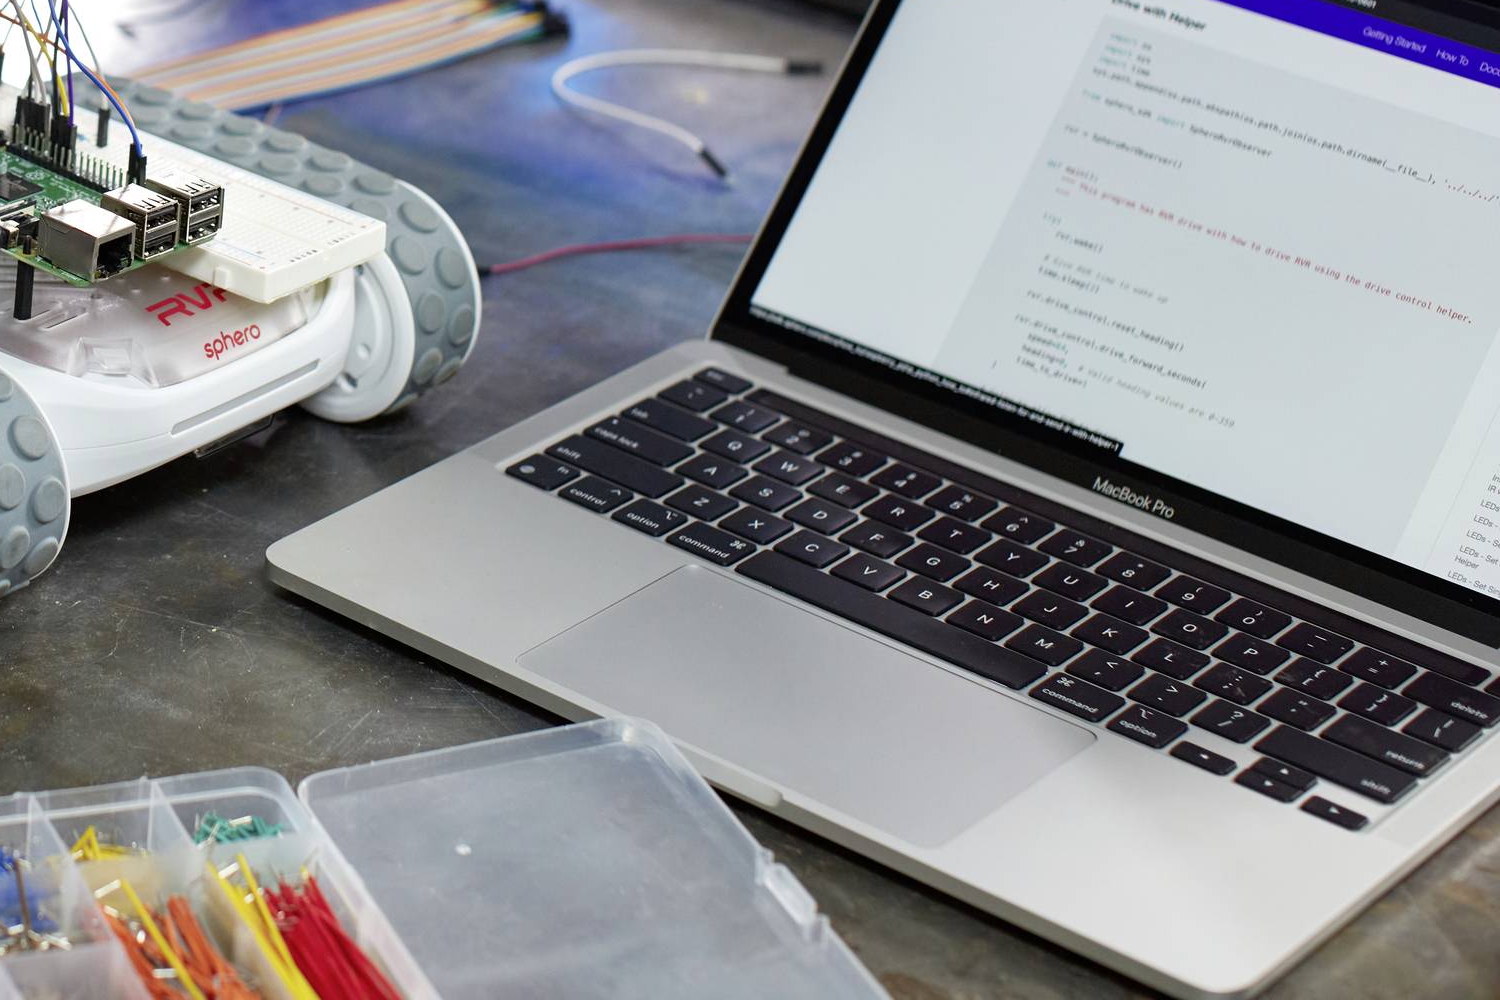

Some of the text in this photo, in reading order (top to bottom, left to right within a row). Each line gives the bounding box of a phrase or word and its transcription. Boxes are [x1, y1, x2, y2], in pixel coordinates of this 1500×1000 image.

[1143, 2, 1166, 19] with
[1168, 10, 1206, 31] Helper
[1363, 26, 1394, 45] Getting
[1395, 35, 1427, 53] Started
[1436, 48, 1457, 63] How
[1459, 54, 1469, 66] To
[1265, 246, 1291, 262] drive
[1295, 255, 1311, 269] RVR
[1315, 264, 1341, 281] using
[1345, 273, 1361, 286] the
[1364, 280, 1391, 297] drive
[1395, 290, 1433, 310] control
[1436, 304, 1473, 325] helper.
[204, 324, 261, 360] sphero
[703, 465, 718, 476] A
[780, 460, 799, 473] W
[758, 487, 773, 498] S
[836, 484, 850, 495] E
[569, 486, 607, 506] control
[1092, 476, 1175, 519] MacBook Pro
[694, 497, 709, 507] Z
[1480, 499, 1500, 512] LEDs
[813, 510, 828, 520] D
[890, 506, 905, 518] R
[626, 512, 660, 530] option
[748, 519, 765, 529] X
[1473, 514, 1493, 528] LEDs
[950, 528, 964, 539] T
[1006, 523, 1020, 533] 6
[869, 533, 884, 543] F
[1466, 529, 1486, 543] LEDs
[678, 532, 730, 559] command
[805, 543, 819, 552] C
[1064, 546, 1078, 555] 7
[1007, 551, 1021, 562] Y
[1459, 545, 1498, 565] LEDs Set
[926, 556, 941, 567] G
[1454, 554, 1479, 569] Helper
[863, 566, 877, 577] V
[1122, 568, 1135, 578] 8
[983, 579, 1000, 591] H
[1063, 574, 1079, 586] U
[1447, 569, 1487, 591] LEDs Set
[918, 590, 933, 600] B
[1181, 592, 1195, 602] 9
[1043, 605, 1057, 614] J
[976, 614, 994, 625] N
[1102, 627, 1118, 638] K
[1035, 637, 1053, 649] M
[1243, 647, 1259, 657] P
[1163, 653, 1174, 663] L
[1041, 687, 1100, 714] command
[1450, 701, 1488, 720] delete
[1119, 719, 1157, 739] option
